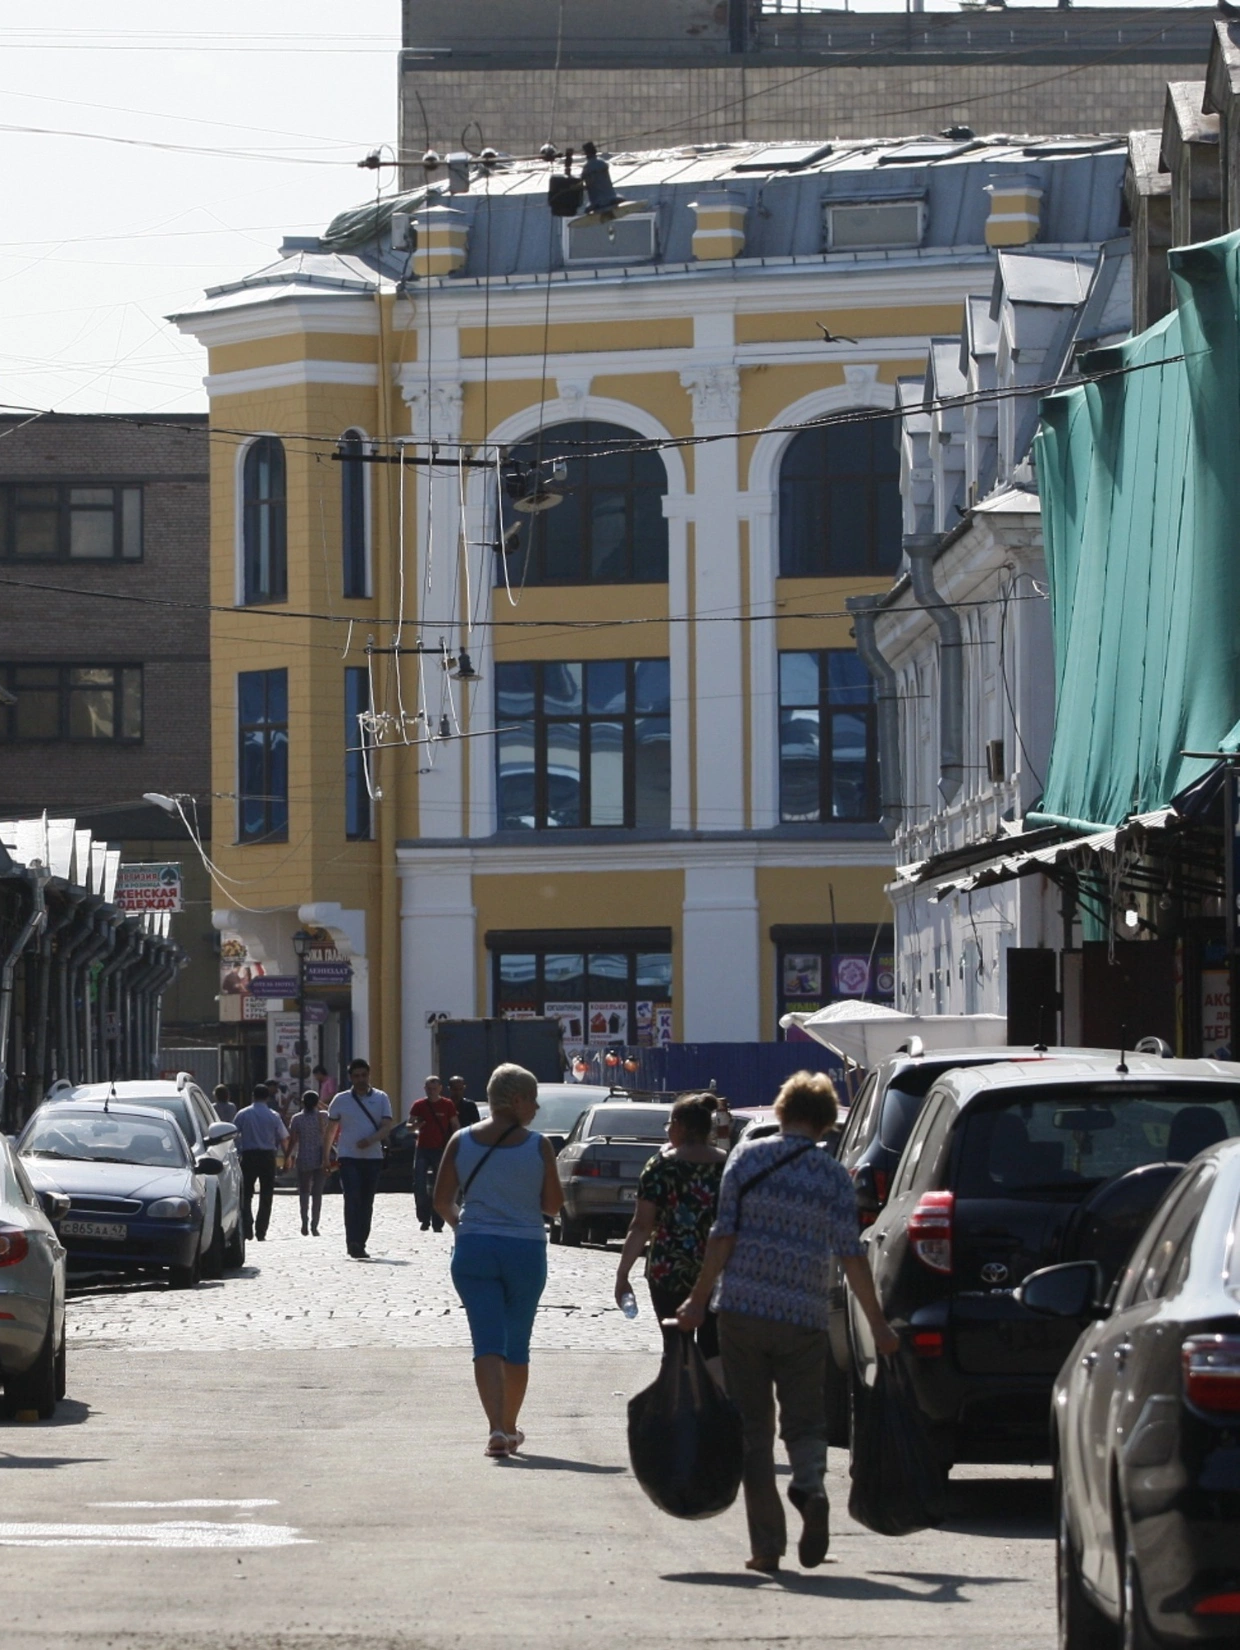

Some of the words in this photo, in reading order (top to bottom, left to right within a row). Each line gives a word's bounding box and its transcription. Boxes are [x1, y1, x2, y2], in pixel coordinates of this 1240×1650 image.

[114, 887, 178, 899] ЖЕНСКАЯ
[117, 898, 176, 911] ОДЕЖДА
[1204, 993, 1233, 1006] АКС
[1204, 1025, 1233, 1039] ТЕЛ
